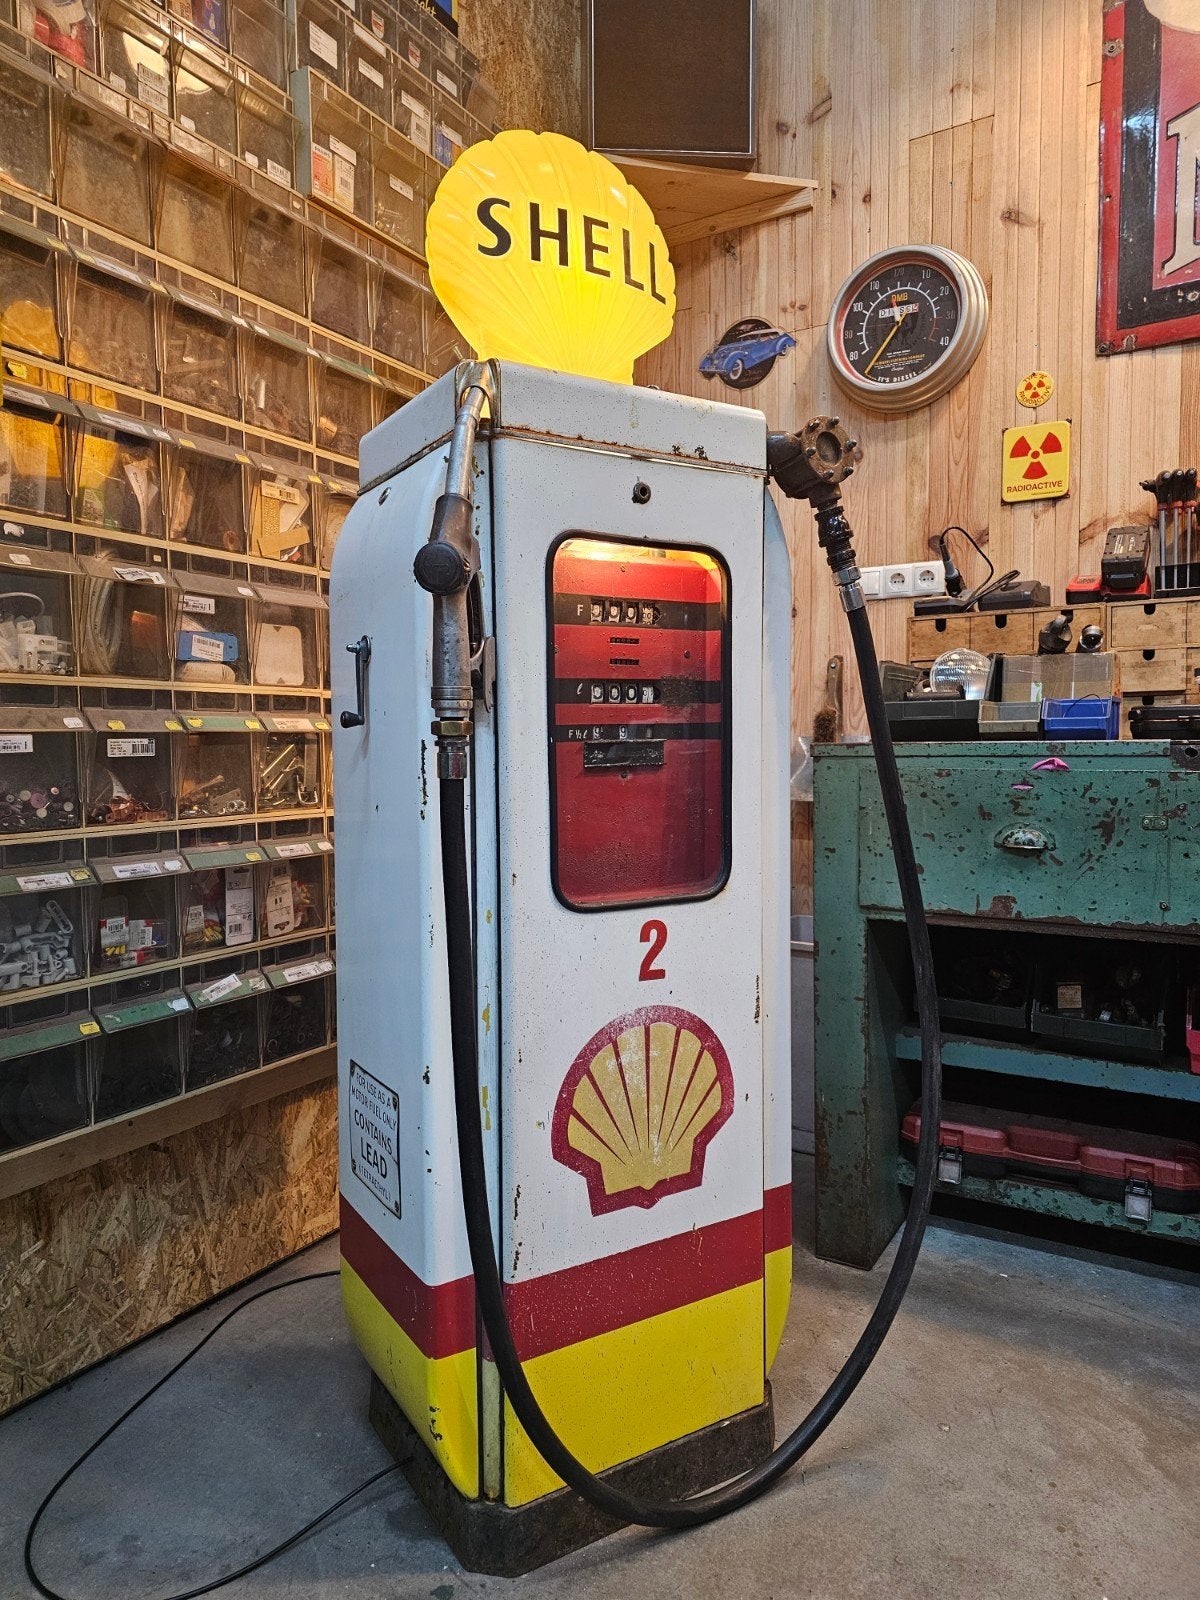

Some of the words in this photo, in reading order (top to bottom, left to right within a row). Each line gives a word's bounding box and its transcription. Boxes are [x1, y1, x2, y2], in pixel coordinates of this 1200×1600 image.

[477, 197, 666, 305] SHELL
[922, 270, 931, 279] 10
[870, 281, 879, 290] 110
[939, 286, 949, 296] 20
[853, 302, 863, 312] 100
[939, 336, 949, 346] 40
[849, 351, 859, 361] 80
[1019, 385, 1051, 404] RADIOACTIVE
[1007, 480, 1063, 493] RADIOACTIVE
[577, 604, 584, 617] F
[638, 919, 668, 982] 2
[356, 1072, 366, 1089] FOR
[366, 1081, 377, 1098] USE
[378, 1090, 385, 1105] AS
[386, 1096, 391, 1109] A
[351, 1085, 369, 1108] MOTOR
[369, 1100, 382, 1120] FUEL
[382, 1111, 397, 1132] ONLY
[354, 1109, 393, 1155] CONTAINS
[361, 1136, 387, 1179] LEAD
